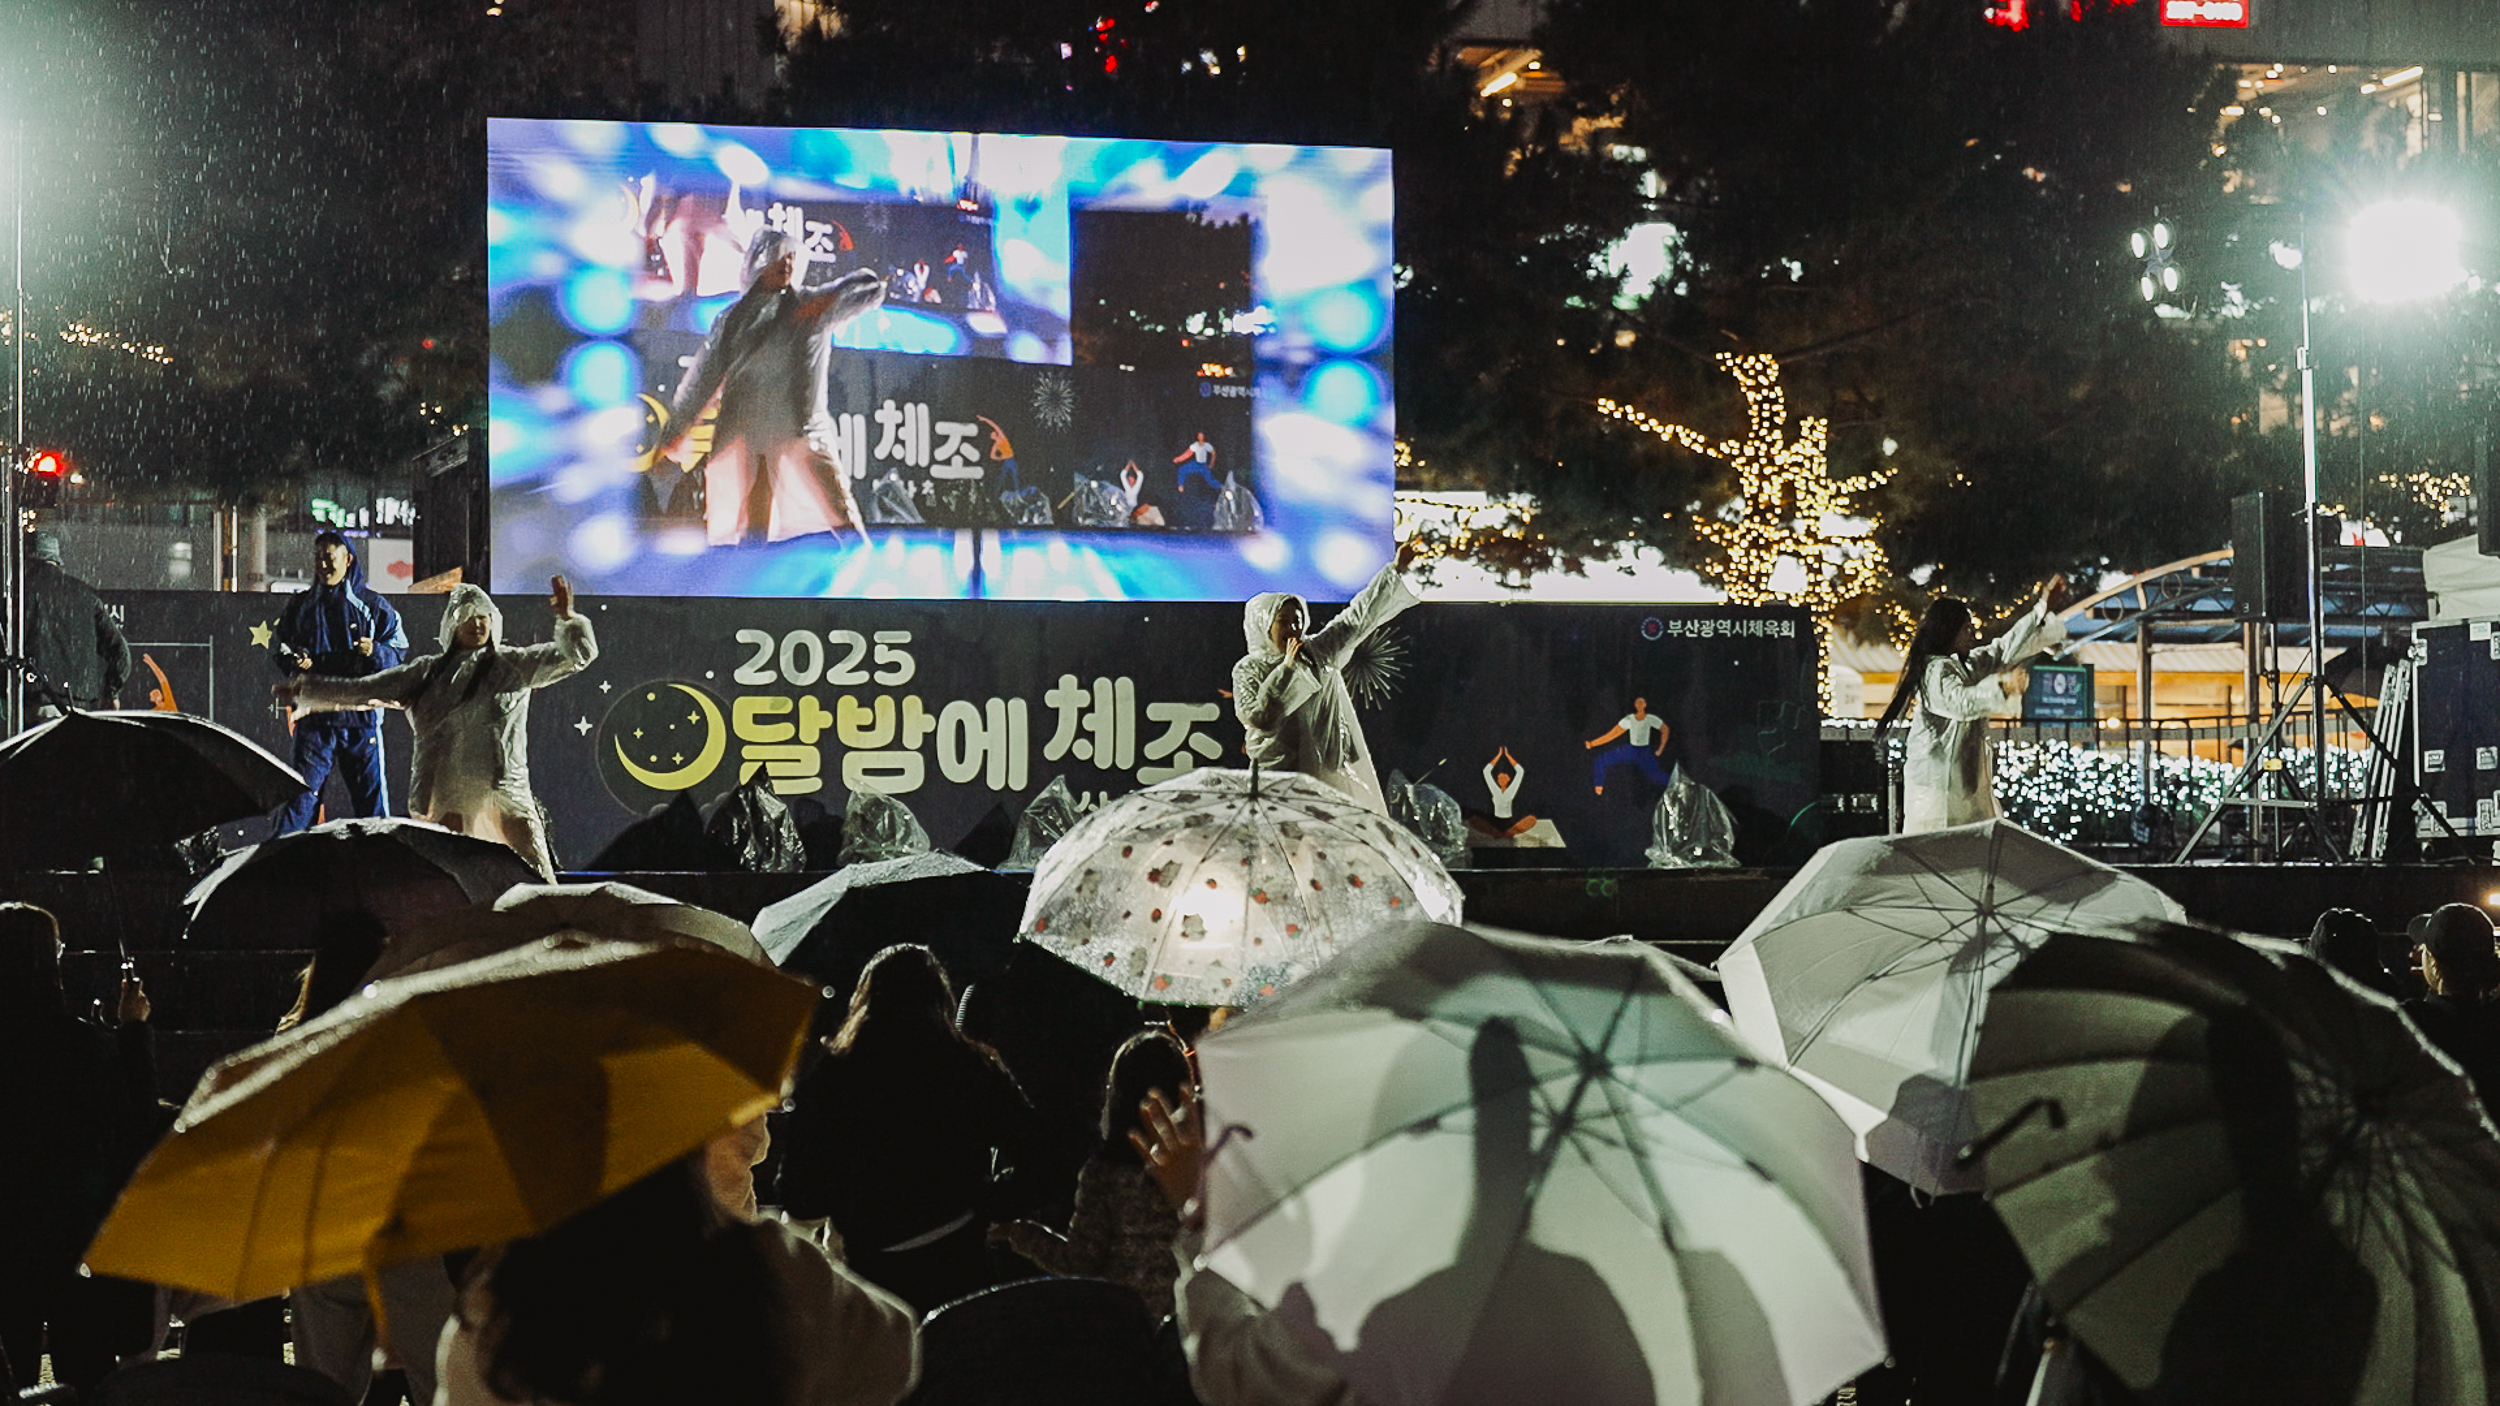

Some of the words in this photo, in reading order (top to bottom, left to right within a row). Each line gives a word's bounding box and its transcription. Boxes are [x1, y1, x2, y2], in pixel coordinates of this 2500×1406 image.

[874, 399, 985, 480] 체조
[733, 629, 916, 687] 2025
[1667, 619, 1795, 638] 부산광역시체육회
[732, 695, 1028, 795] 달밤에
[1044, 675, 1223, 786] 체조
